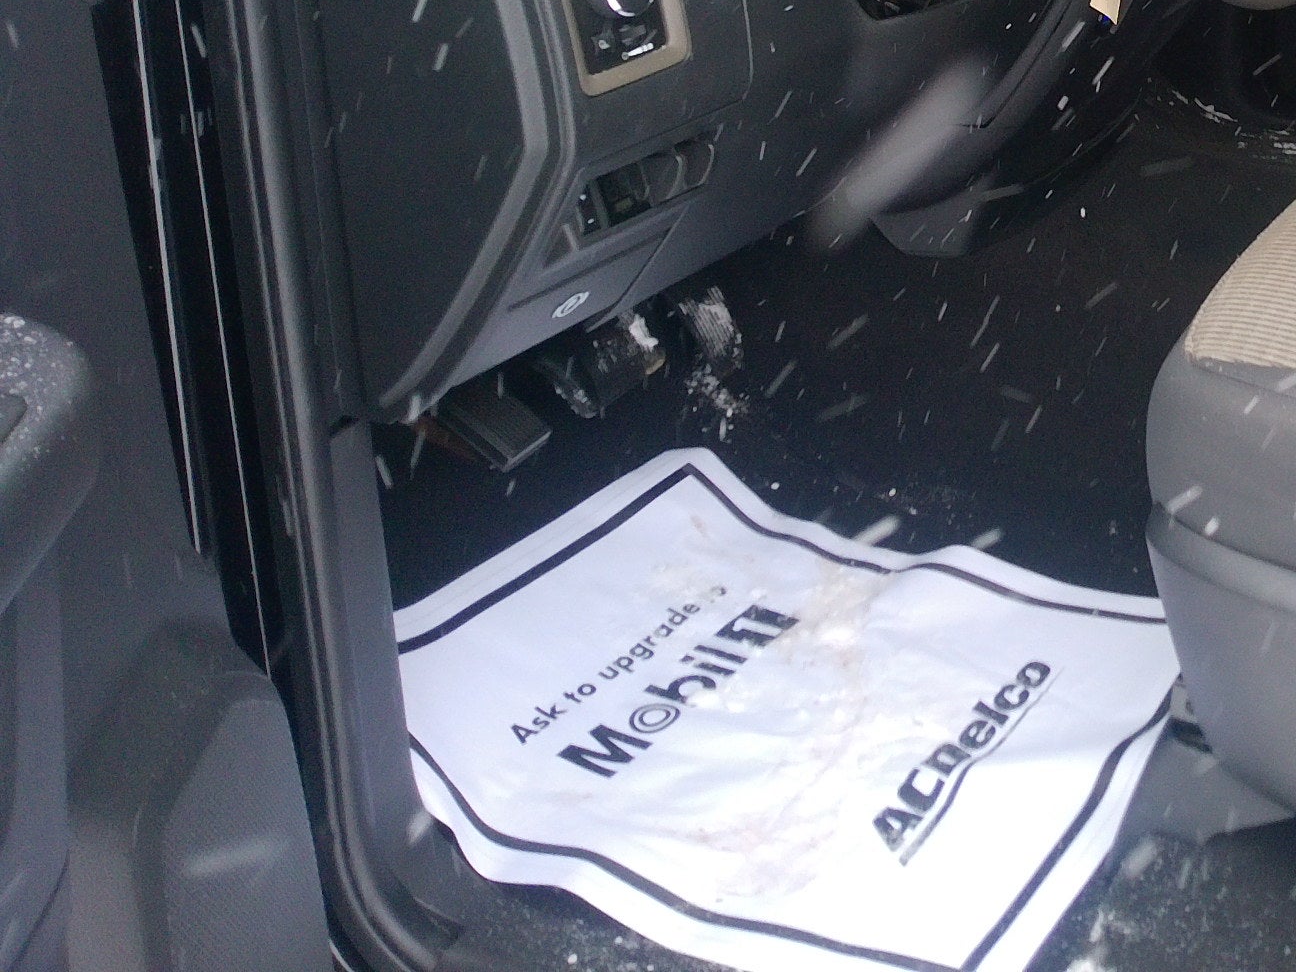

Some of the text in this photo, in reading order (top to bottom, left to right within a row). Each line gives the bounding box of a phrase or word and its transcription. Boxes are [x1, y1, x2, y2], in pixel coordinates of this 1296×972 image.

[510, 703, 568, 744] Ask
[563, 682, 597, 704] to
[598, 603, 701, 680] upgrade
[556, 644, 748, 778] Mobil
